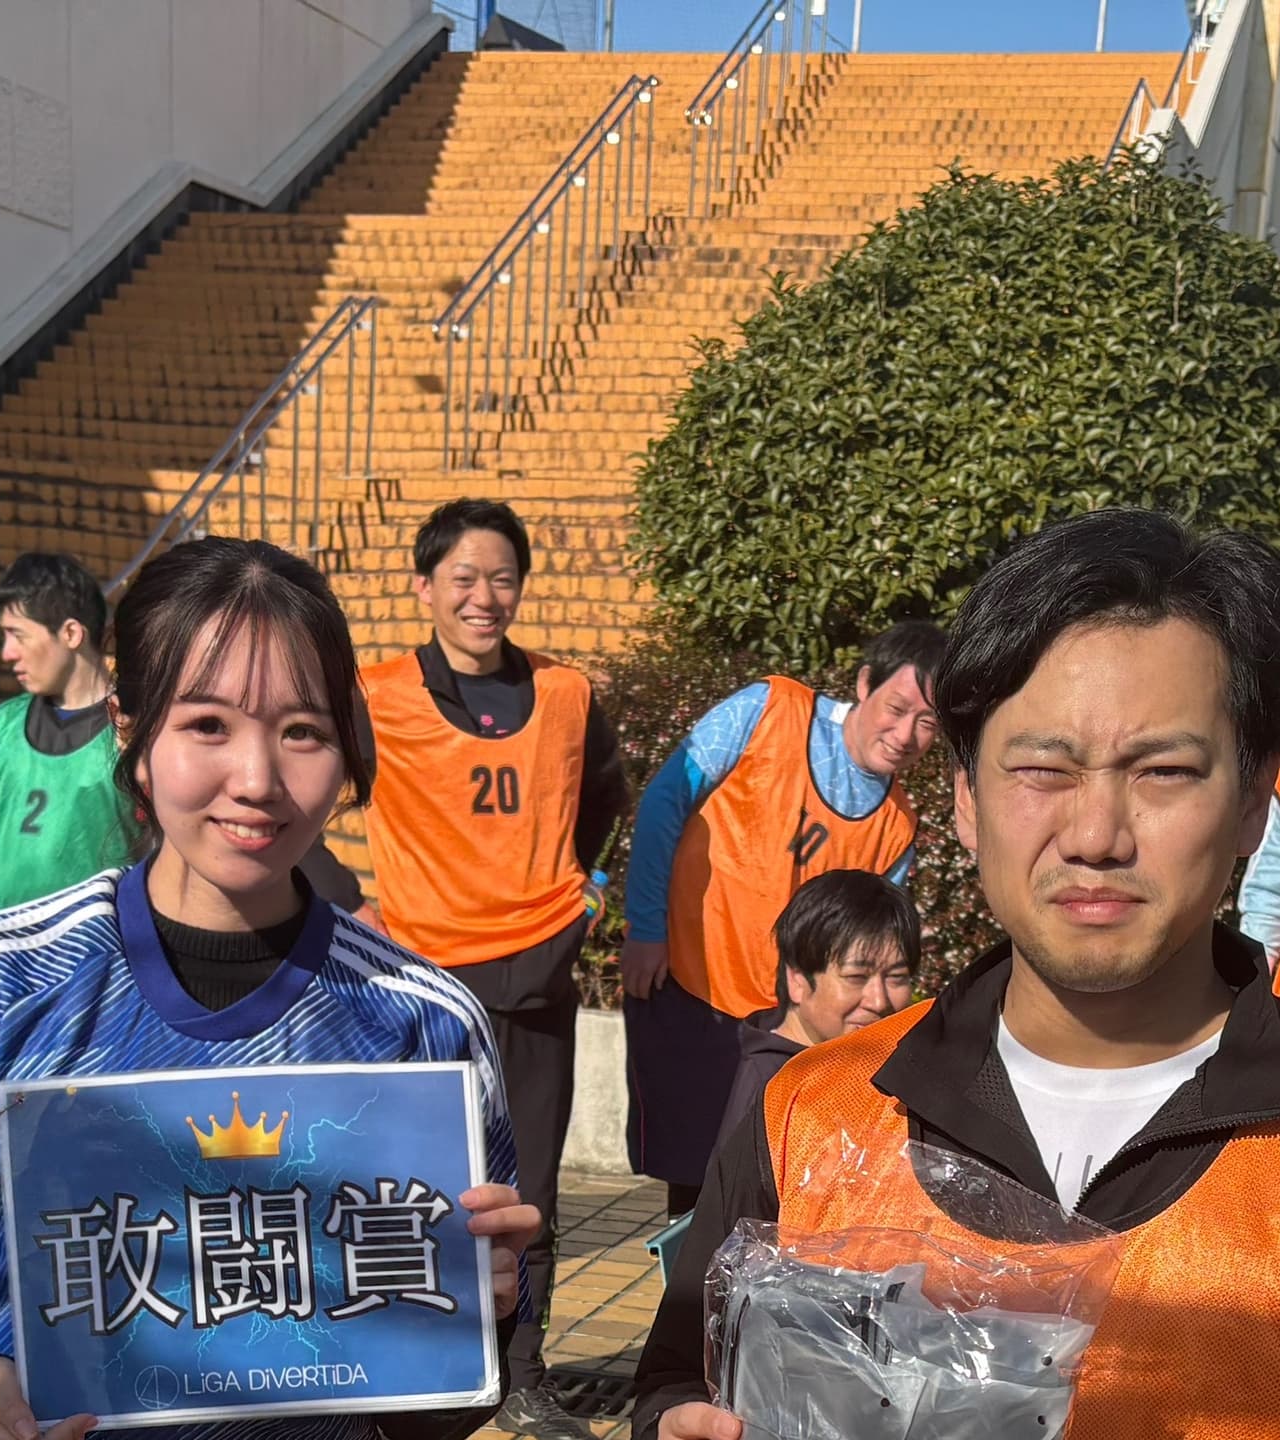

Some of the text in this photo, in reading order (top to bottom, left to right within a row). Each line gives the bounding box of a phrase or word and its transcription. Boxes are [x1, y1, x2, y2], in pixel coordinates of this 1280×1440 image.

[19, 788, 48, 834] 2
[470, 765, 520, 816] 20
[34, 1177, 457, 1336] 敢闘賞
